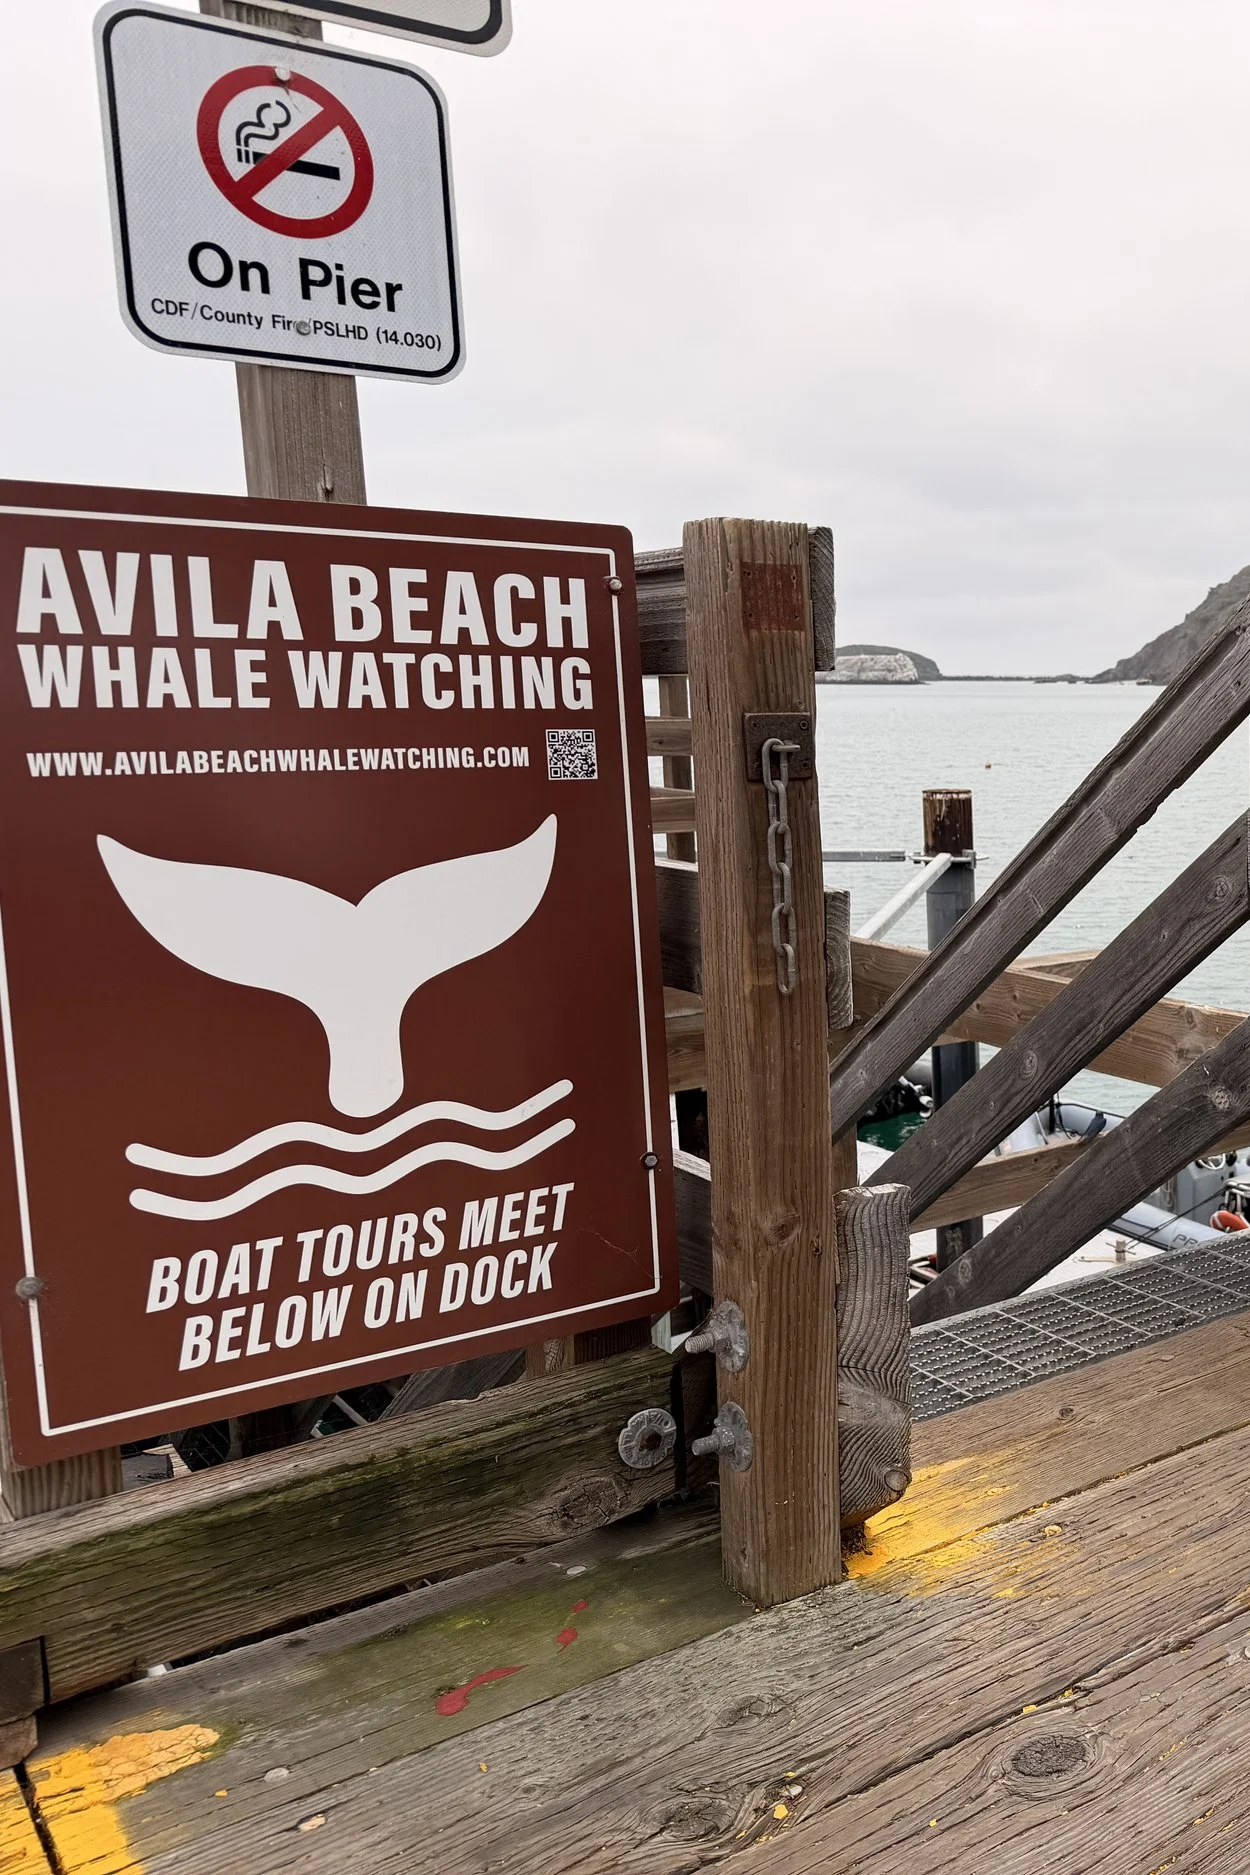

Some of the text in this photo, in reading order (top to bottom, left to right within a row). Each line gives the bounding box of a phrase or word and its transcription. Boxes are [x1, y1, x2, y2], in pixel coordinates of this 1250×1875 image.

[188, 241, 403, 313] On Pier
[151, 298, 263, 330] CDF/County
[376, 326, 442, 352] (14.030)
[16, 547, 590, 649] AVILA BEACH
[17, 644, 594, 710] WHALE WATCHING
[26, 747, 531, 778] WWW.AVILABEACHWHALEWATCHING.COM
[146, 1182, 575, 1314] BOAT TOURS MEET
[178, 1242, 559, 1371] BELOW ON DOCK
